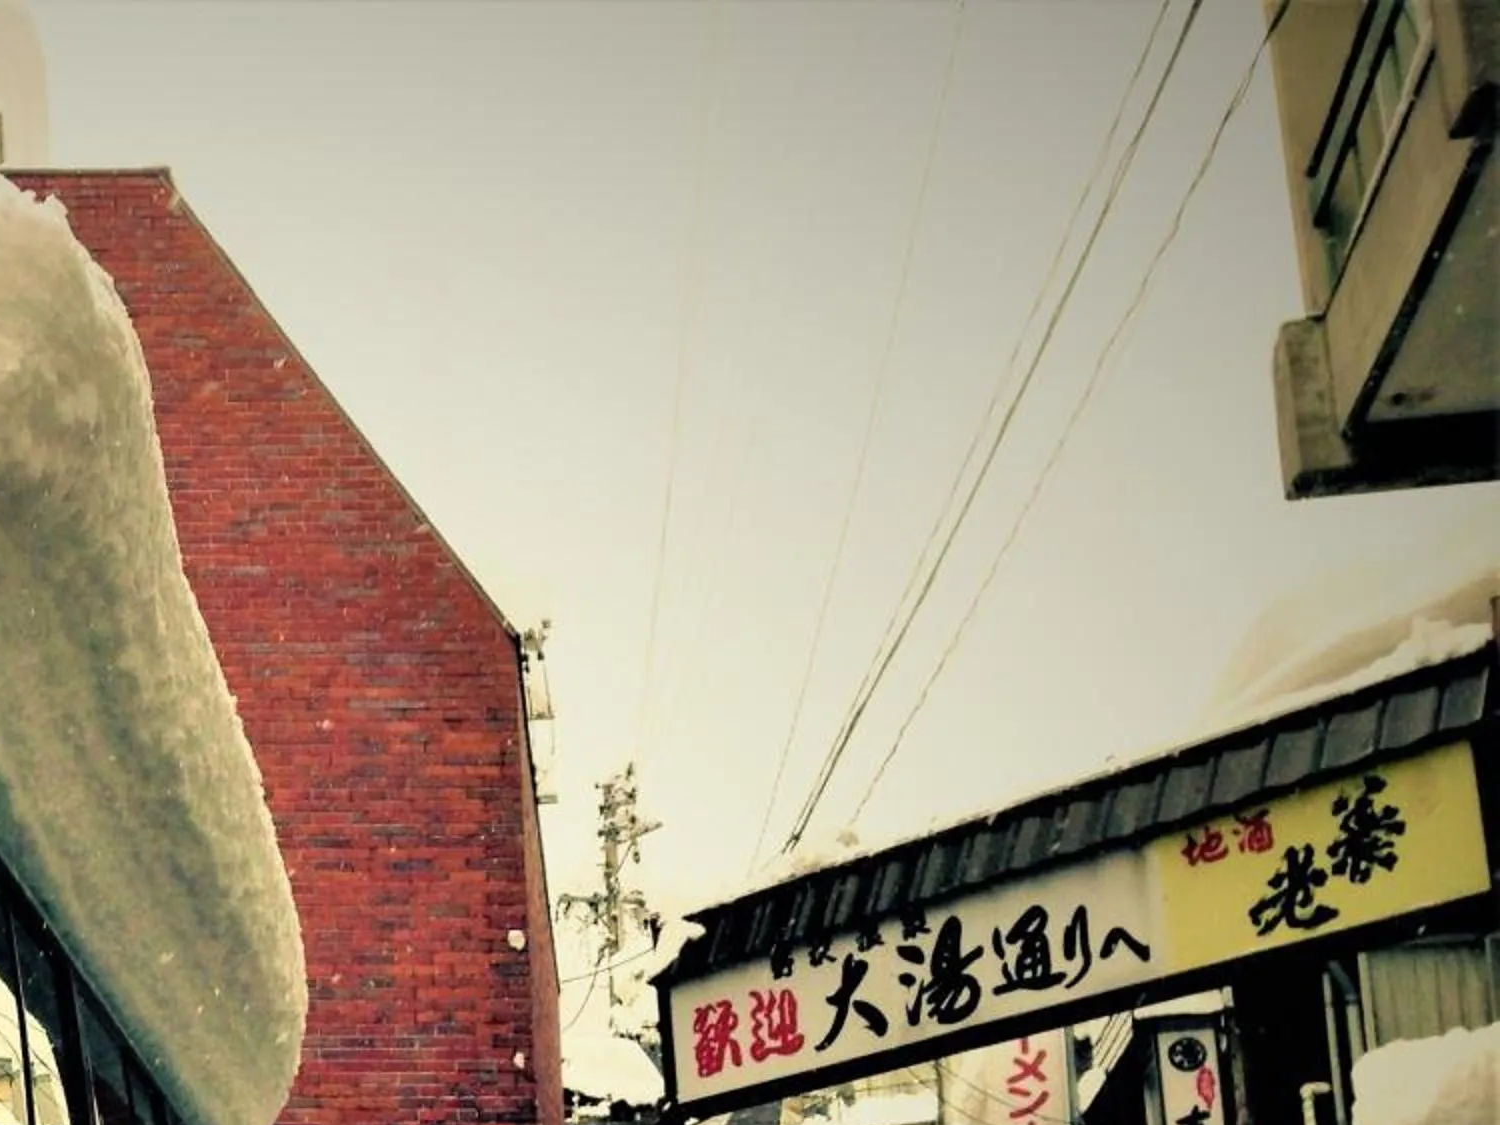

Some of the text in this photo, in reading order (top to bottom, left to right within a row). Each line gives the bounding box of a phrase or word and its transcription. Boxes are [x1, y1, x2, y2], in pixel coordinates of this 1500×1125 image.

[1181, 808, 1275, 868] 地酒
[814, 904, 1150, 1051] 大湯通りへ
